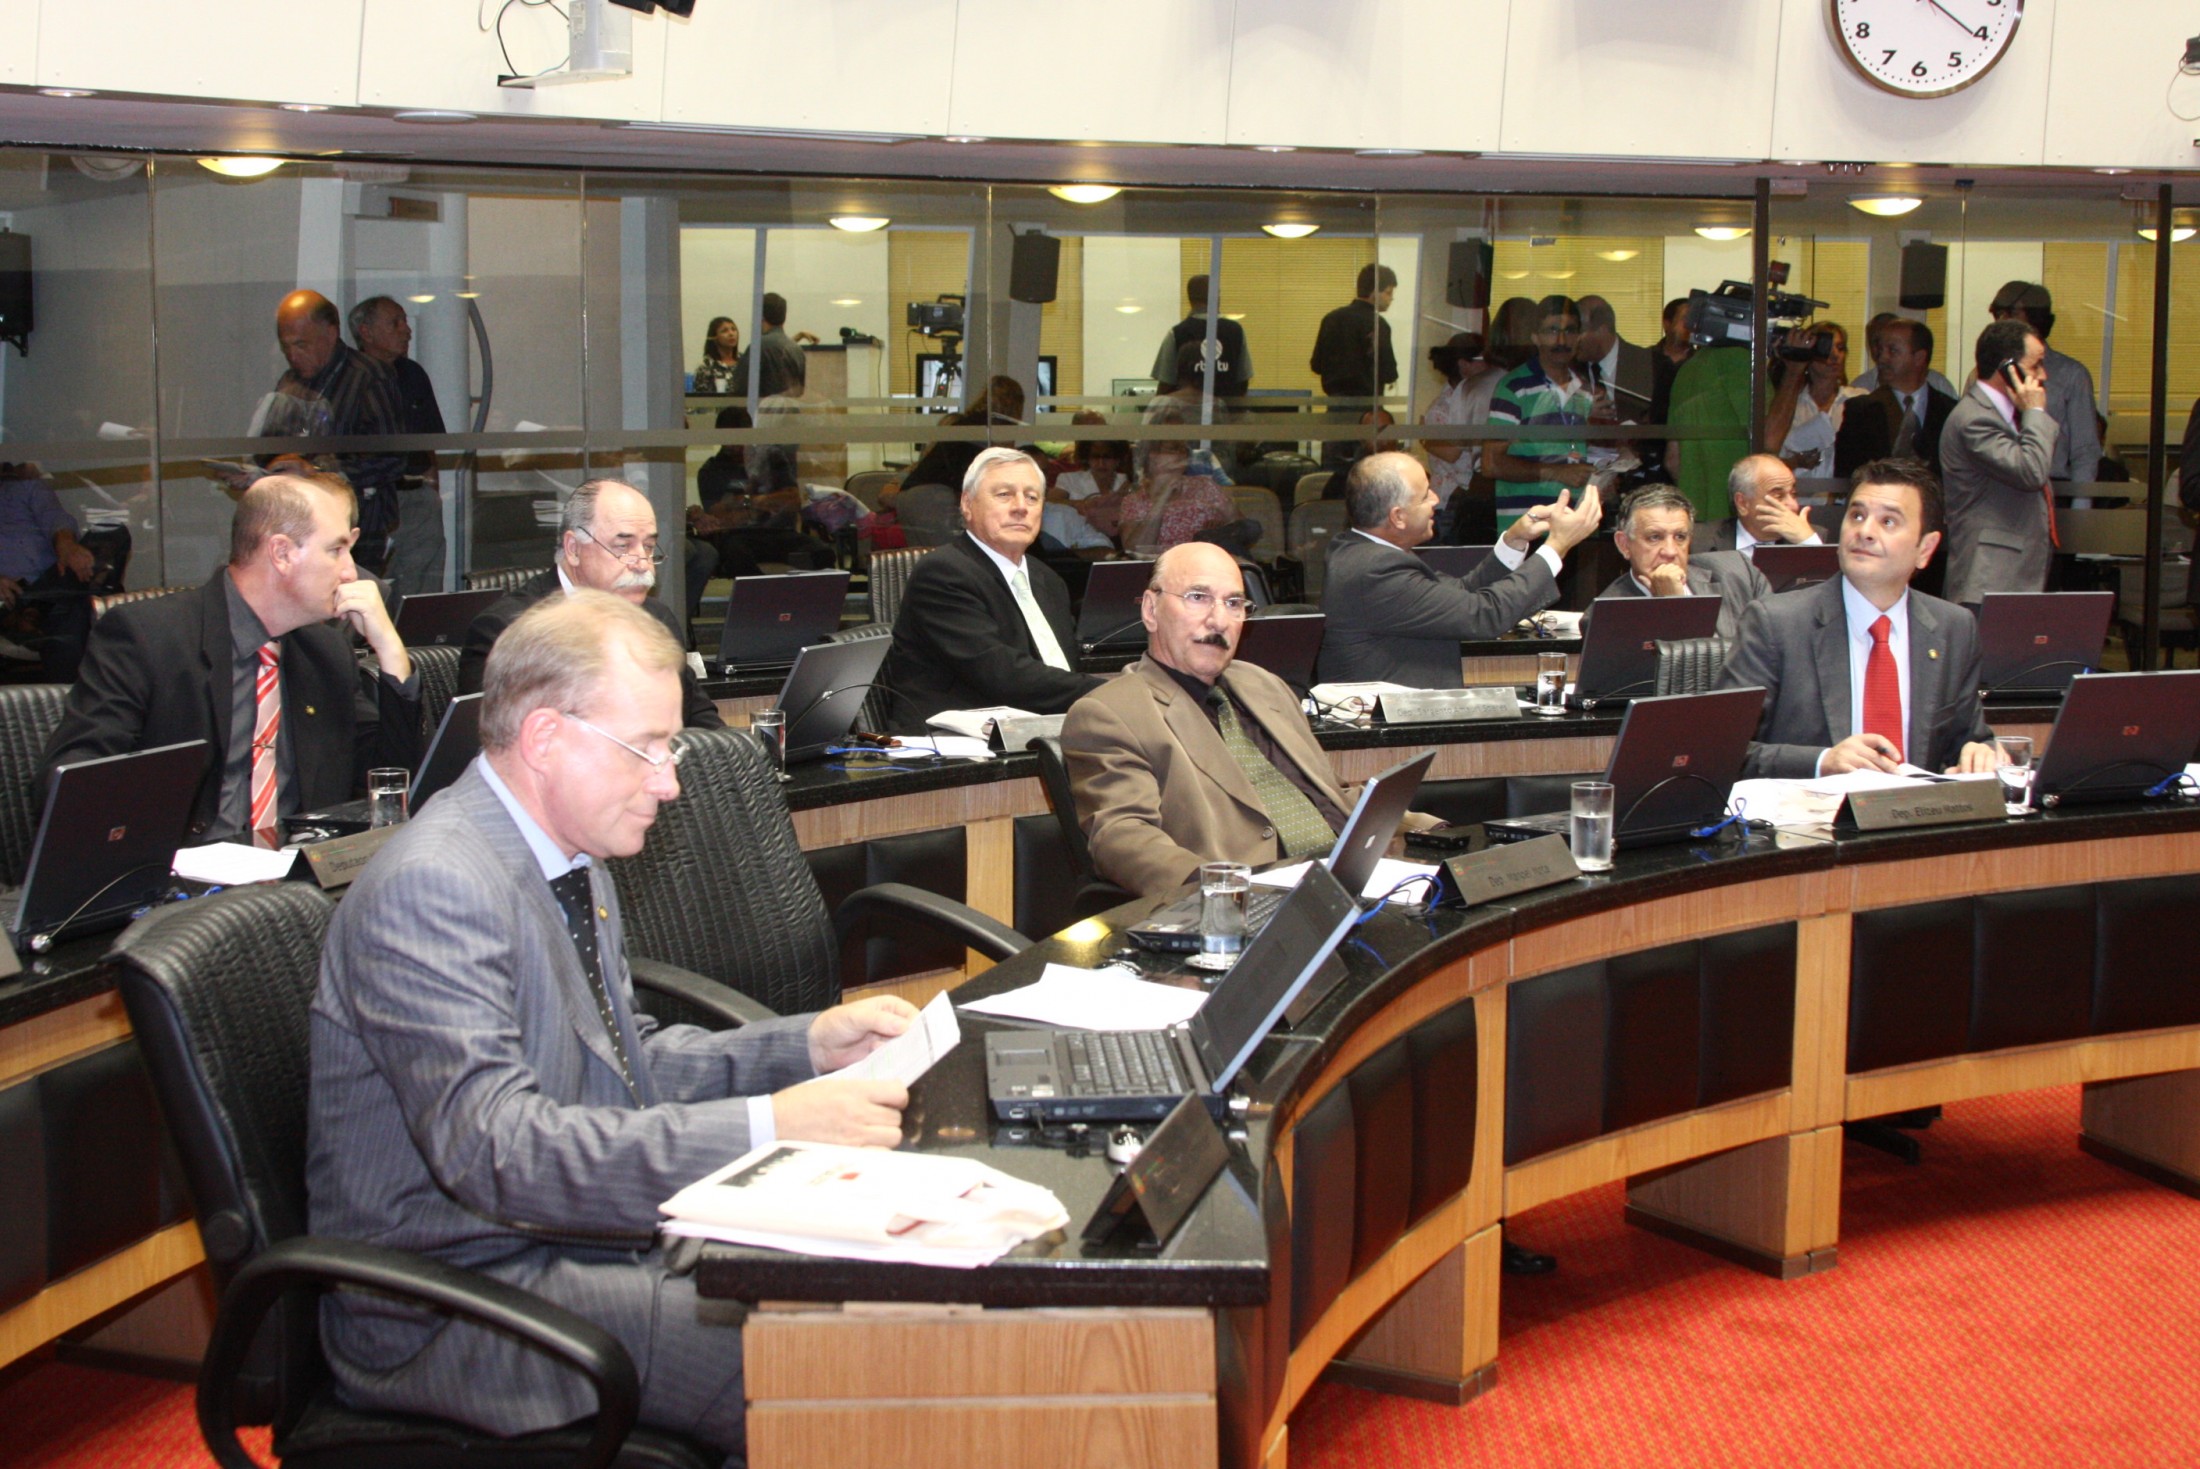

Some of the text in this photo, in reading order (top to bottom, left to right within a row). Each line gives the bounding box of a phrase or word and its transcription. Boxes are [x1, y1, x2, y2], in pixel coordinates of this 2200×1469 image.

[1855, 22, 1870, 39] 8
[1973, 26, 1989, 41] 4
[1881, 50, 1897, 66] 7
[1947, 52, 1962, 68] 5
[1911, 61, 1928, 77] 6
